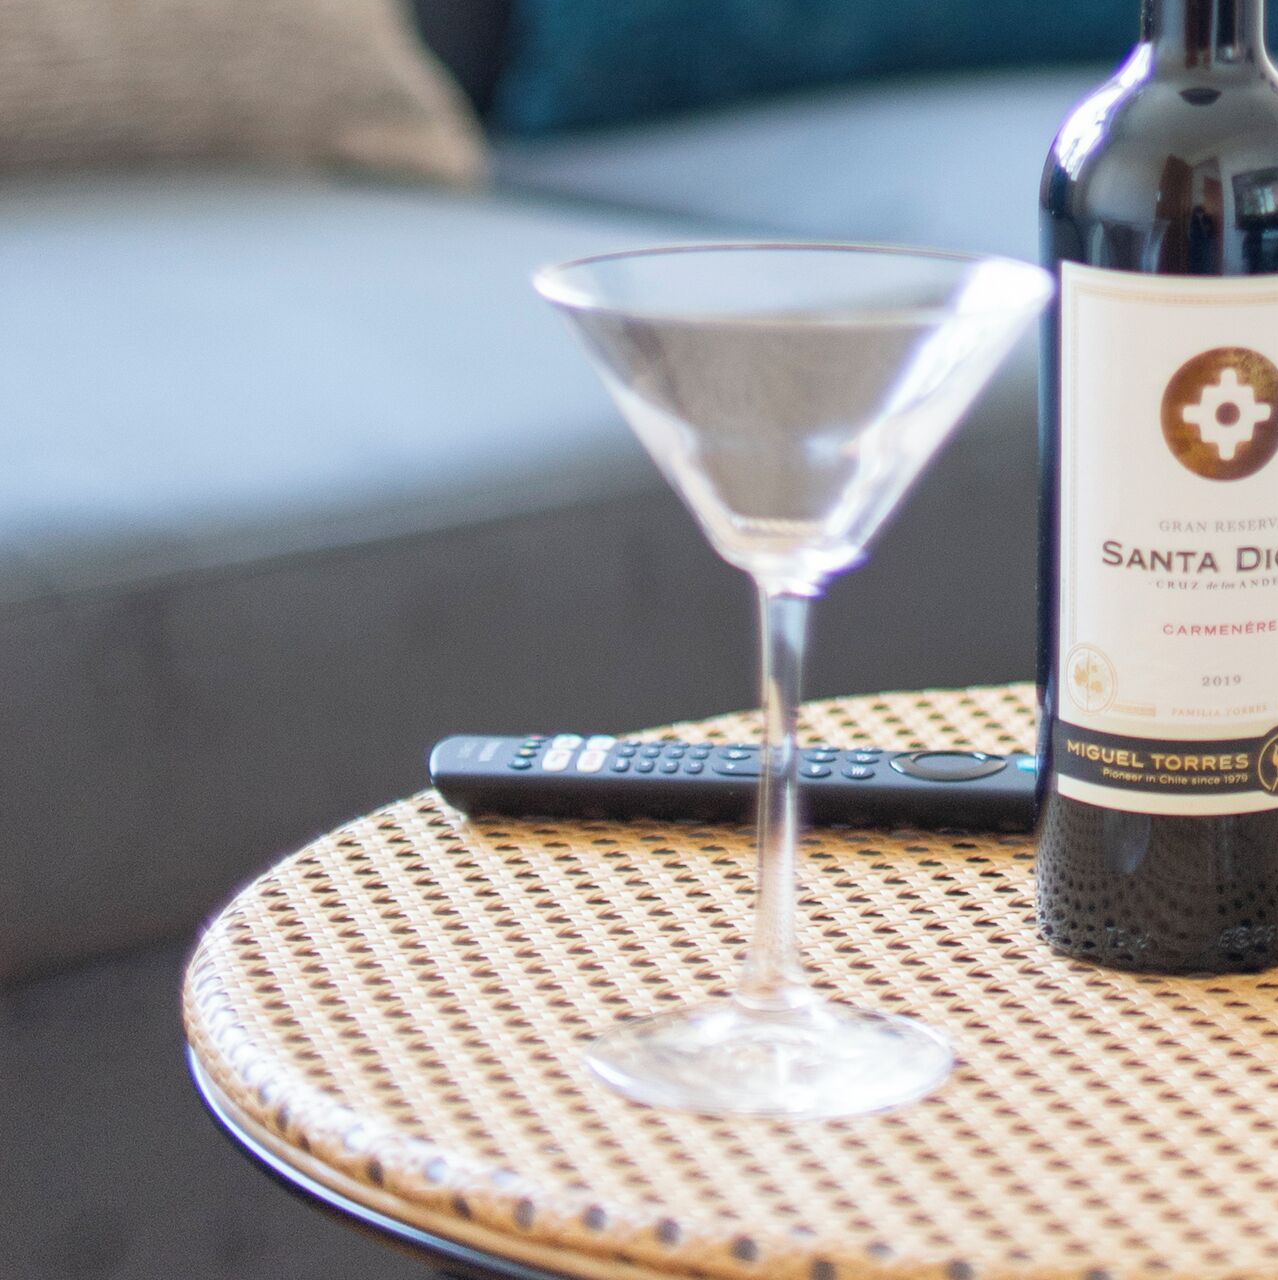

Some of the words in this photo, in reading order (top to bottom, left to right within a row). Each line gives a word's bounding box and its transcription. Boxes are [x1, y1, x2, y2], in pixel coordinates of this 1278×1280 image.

[1159, 519, 1208, 533] GRAN
[1102, 540, 1219, 573] SANTA
[1156, 580, 1199, 590] CRUZ
[1206, 580, 1218, 590] de
[1221, 580, 1235, 590] los
[1201, 674, 1243, 688] 2019
[1171, 707, 1220, 718] FAMILIA
[1067, 739, 1144, 768] MIGUEL
[1151, 753, 1249, 771] TORRES
[1102, 768, 1143, 782] Pioneer
[1145, 773, 1156, 783] in
[1159, 774, 1188, 785] Chile
[1191, 774, 1221, 785] since
[1223, 773, 1249, 785] 1979
